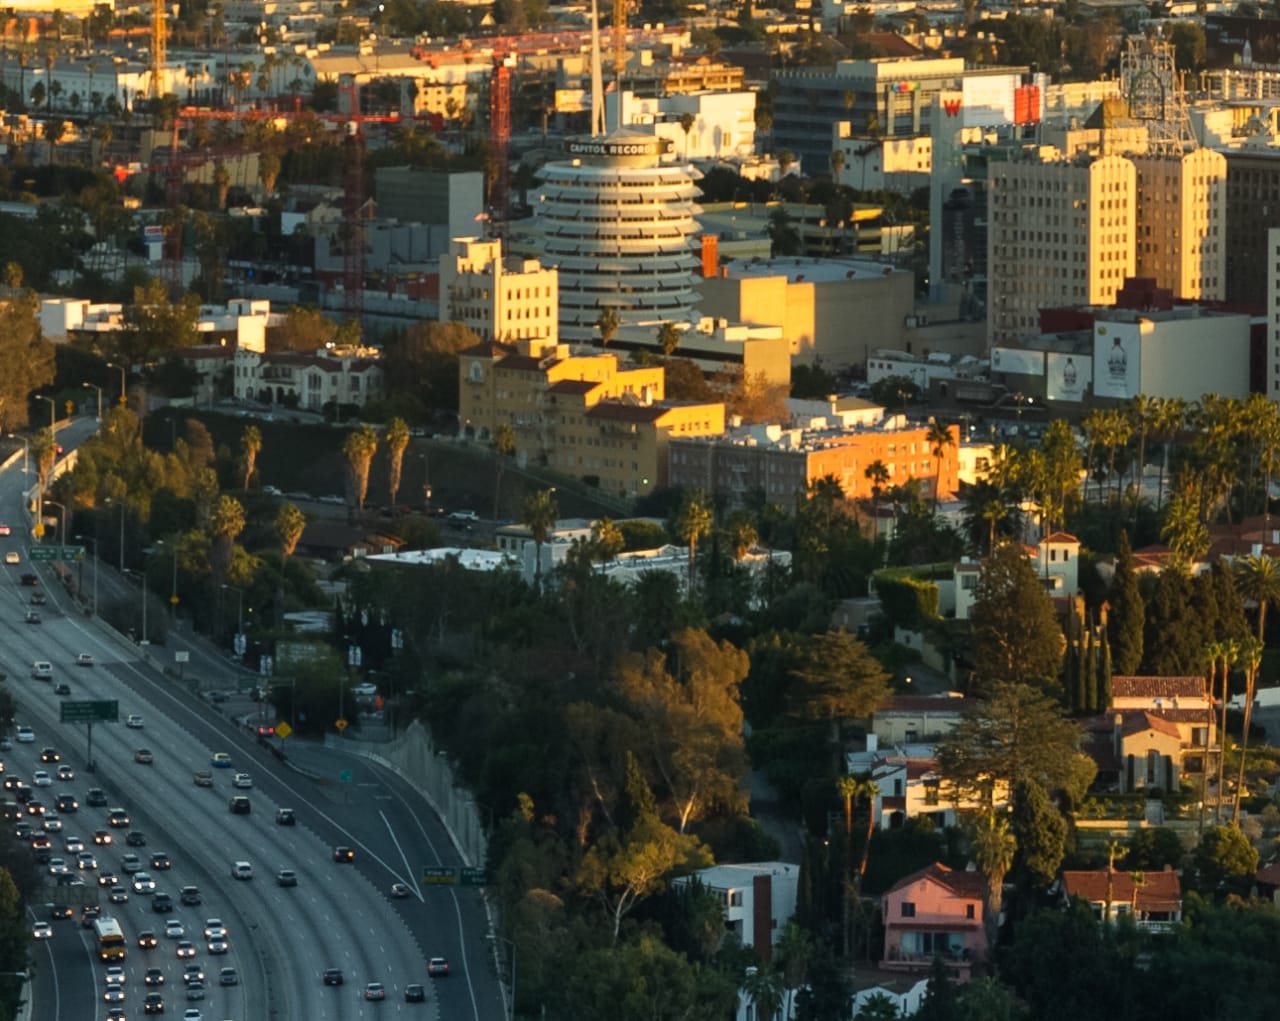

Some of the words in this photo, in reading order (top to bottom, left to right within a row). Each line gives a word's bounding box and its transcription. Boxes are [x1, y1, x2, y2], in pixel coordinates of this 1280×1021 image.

[944, 99, 961, 117] W
[570, 144, 607, 153] CAPITOL
[610, 144, 657, 154] RECORDS
